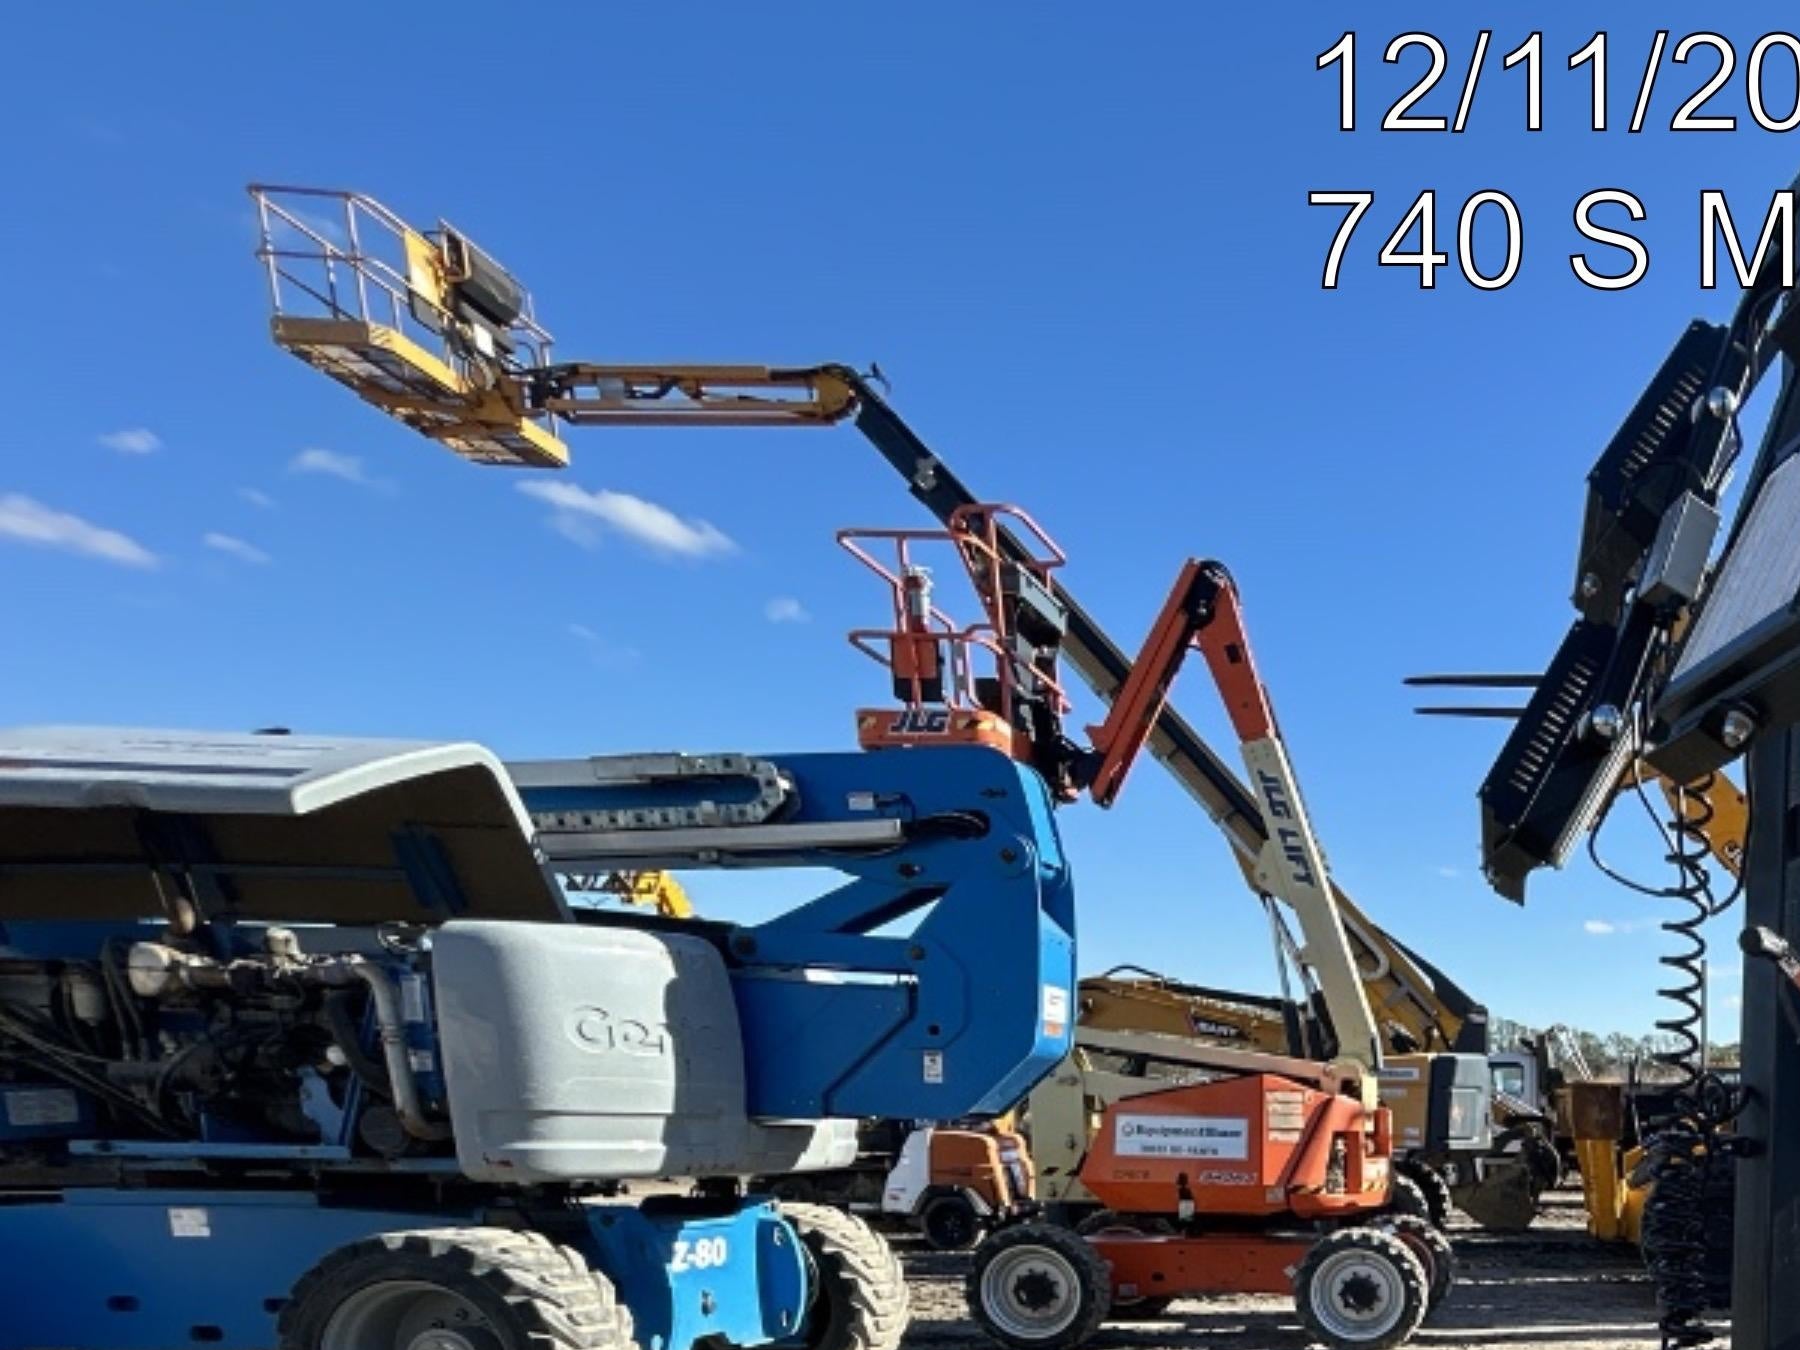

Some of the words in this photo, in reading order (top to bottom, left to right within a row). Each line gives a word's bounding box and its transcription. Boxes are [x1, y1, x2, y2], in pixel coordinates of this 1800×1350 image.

[889, 709, 950, 735] JLG
[1257, 769, 1292, 819] JLG
[1278, 827, 1315, 887] LIFT
[671, 1236, 727, 1272] Z-80
